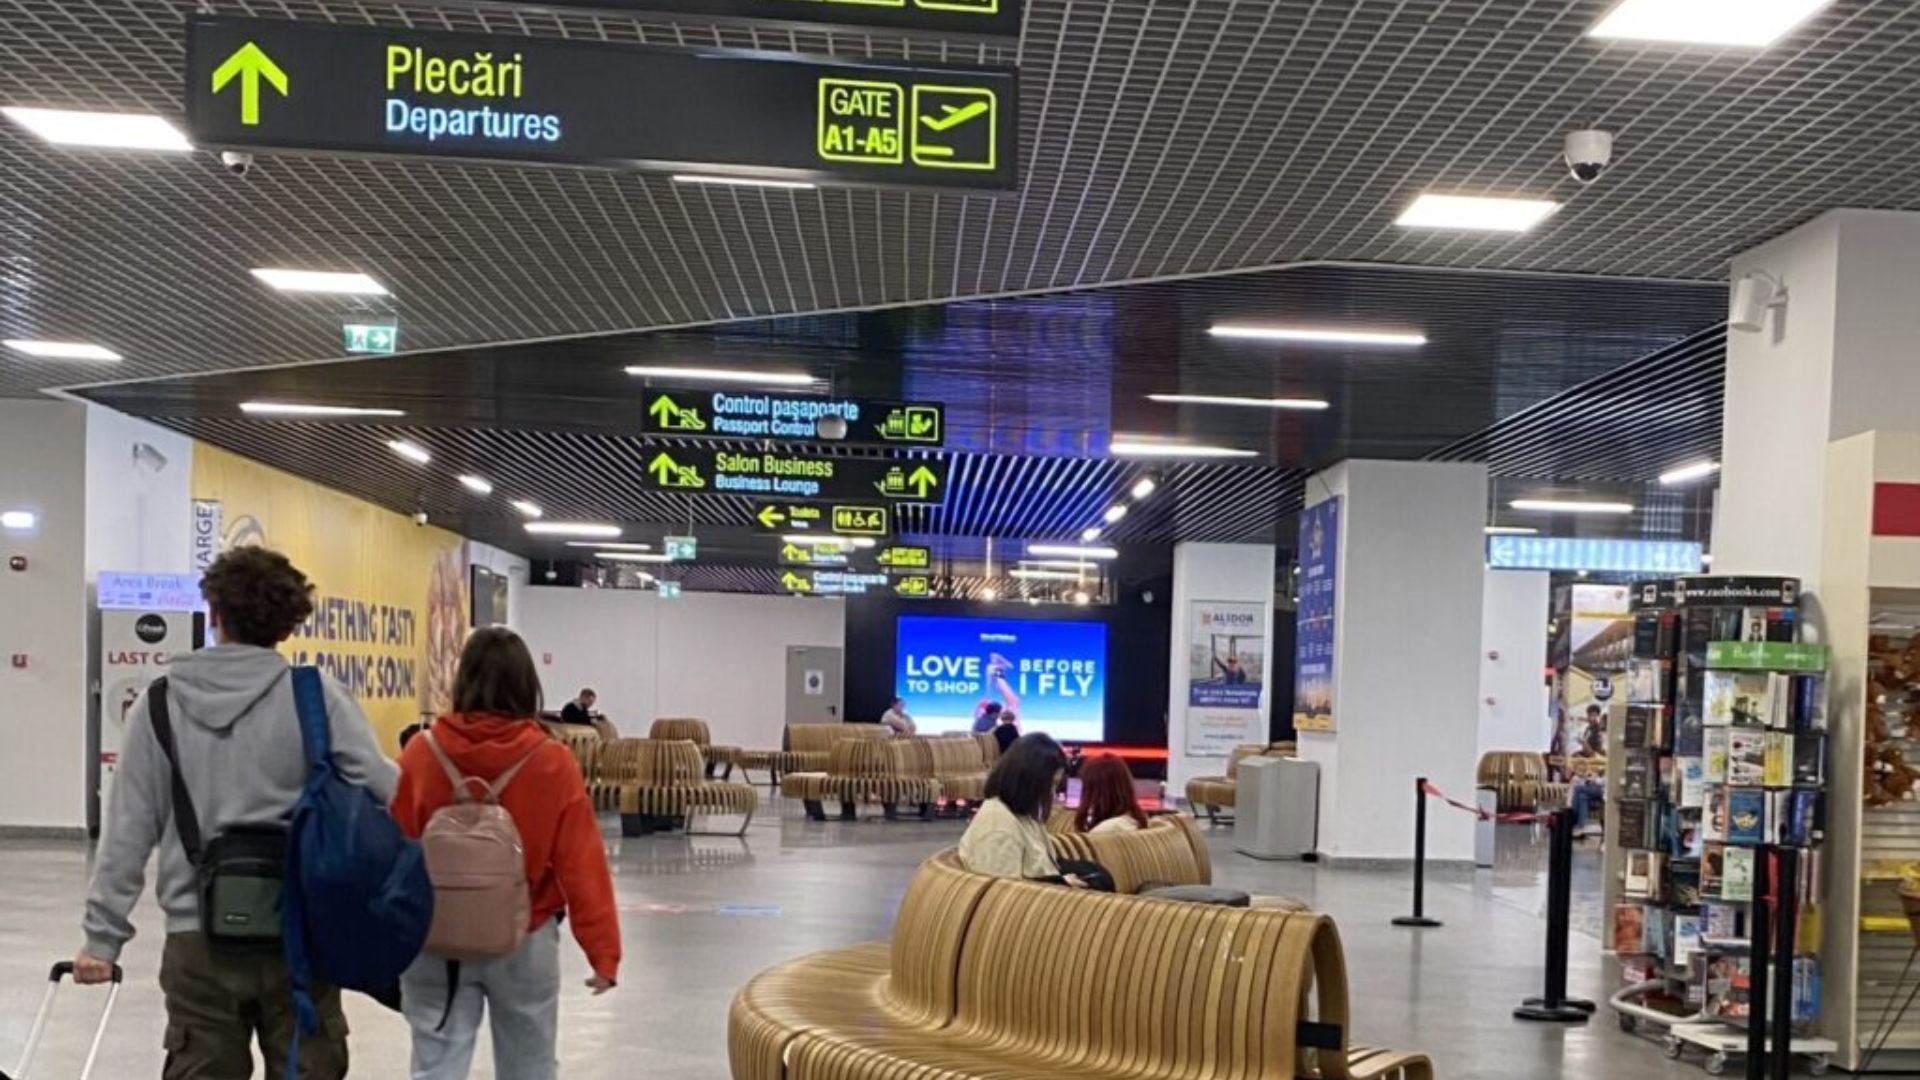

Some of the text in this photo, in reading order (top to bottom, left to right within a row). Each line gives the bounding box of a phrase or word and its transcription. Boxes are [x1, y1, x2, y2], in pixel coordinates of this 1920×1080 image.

[387, 45, 522, 98] Plecări
[830, 88, 892, 117] GATE
[386, 99, 560, 141] Departures
[824, 124, 897, 154] A1-A5
[713, 393, 769, 415] Control
[713, 416, 815, 436] Passport Control
[715, 452, 833, 477] Salon Business
[715, 474, 819, 495] Business Lounge
[108, 652, 149, 665] LAST
[906, 655, 980, 677] LOVE
[1020, 659, 1095, 674] BEFORE
[907, 680, 979, 694] TO SHOP
[1020, 674, 1093, 696] I FLY
